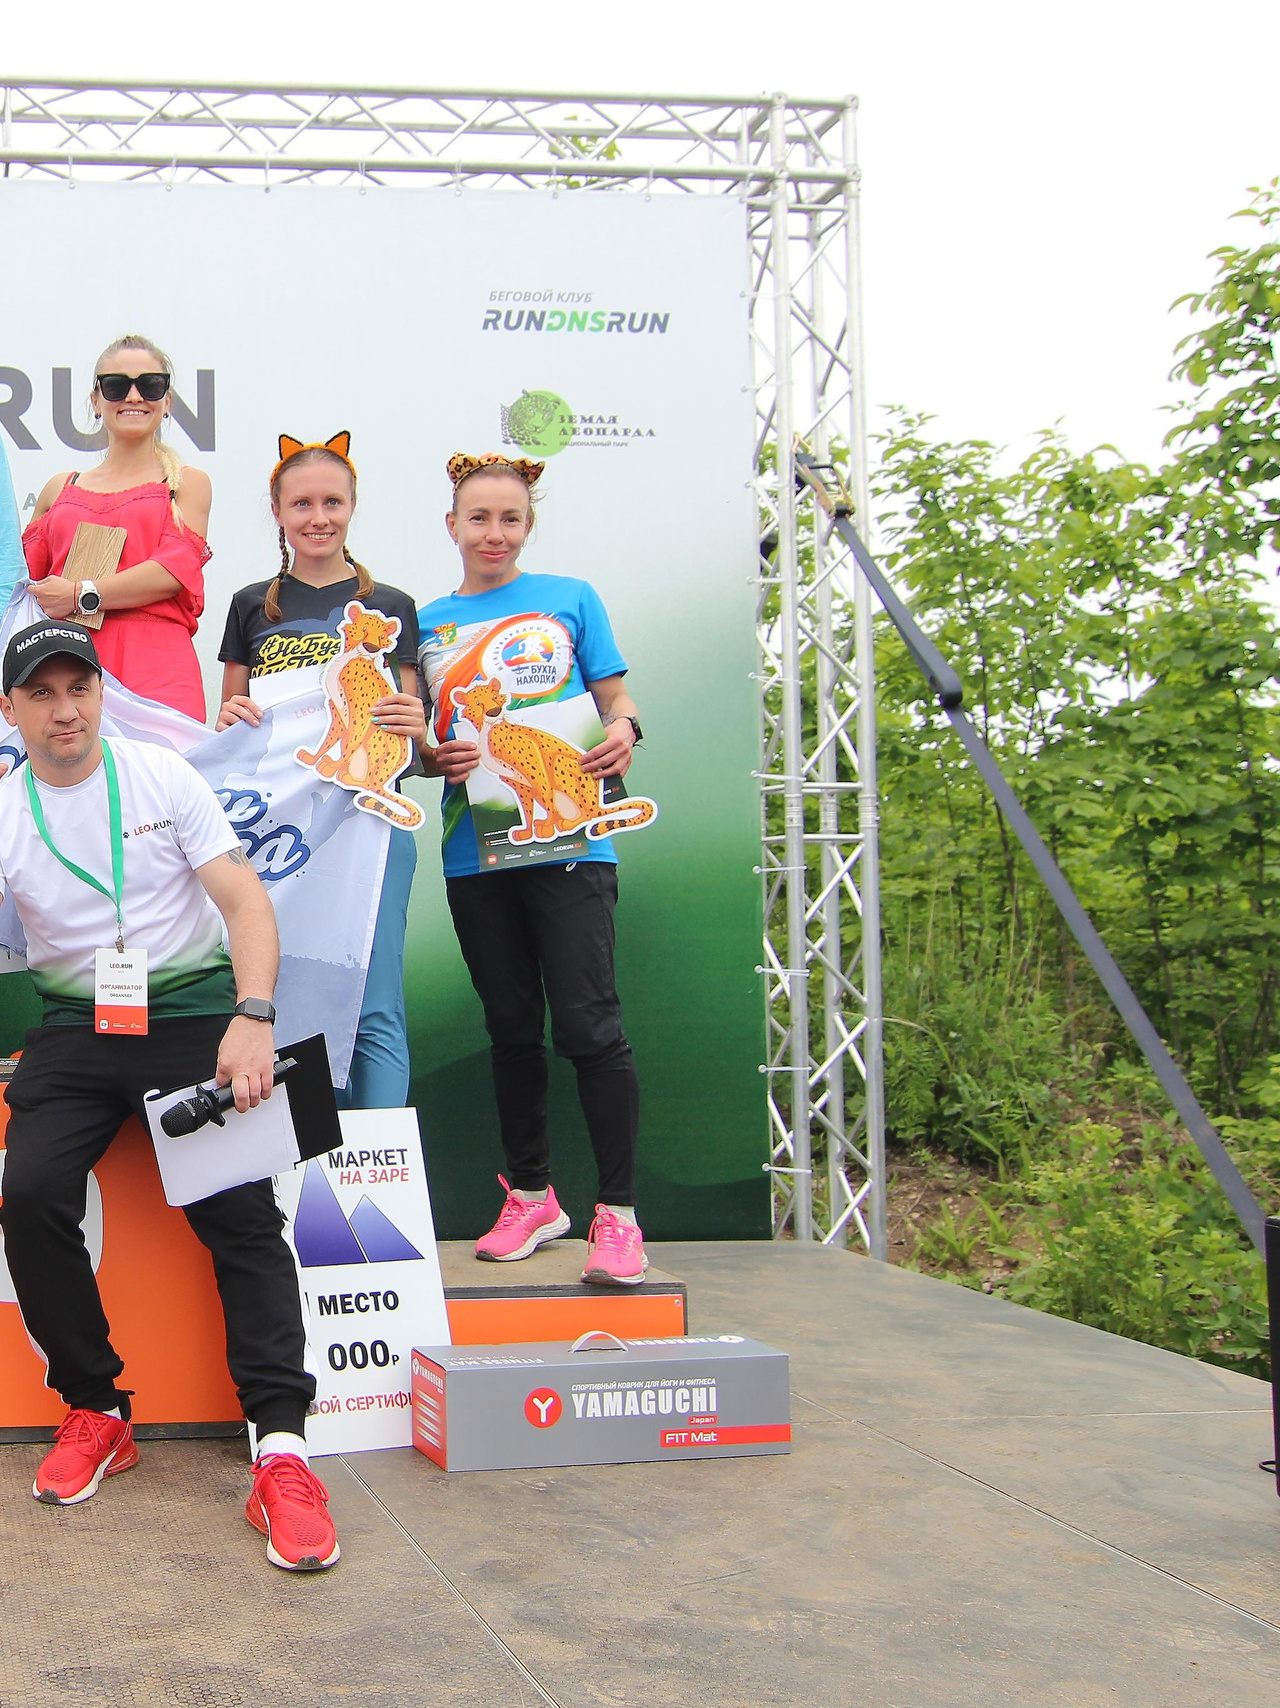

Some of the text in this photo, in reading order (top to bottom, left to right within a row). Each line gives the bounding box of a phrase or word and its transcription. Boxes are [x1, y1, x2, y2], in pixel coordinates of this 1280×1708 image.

[489, 289, 593, 303] БЕГОВОЙ КЛУБ
[481, 308, 671, 334] RUNDNSRUN
[559, 415, 618, 424] ЗЕМЛЯ
[559, 427, 656, 437] ЛЕОПАРДА
[16, 628, 88, 653] МАСТЕРСТВО
[531, 665, 557, 675] БУХТА
[516, 674, 556, 686] НАХОДКА
[134, 818, 173, 837] LEO.RUN
[328, 1149, 408, 1168] МАРКЕТ
[340, 1168, 409, 1185] НА ЗАРЕ
[318, 1290, 399, 1316] МЕСТО
[571, 1381, 616, 1391] СПОРТИВНЫЙ
[617, 1380, 644, 1389] КОВРИК
[644, 1380, 659, 1388] ДЛЯ
[660, 1378, 678, 1387] ЙОГИ
[686, 1378, 716, 1386] ФИТНЕСА
[572, 1386, 717, 1418] YAMAGUCHI
[690, 1417, 715, 1425] Japan
[665, 1430, 718, 1444] FIT Mat
